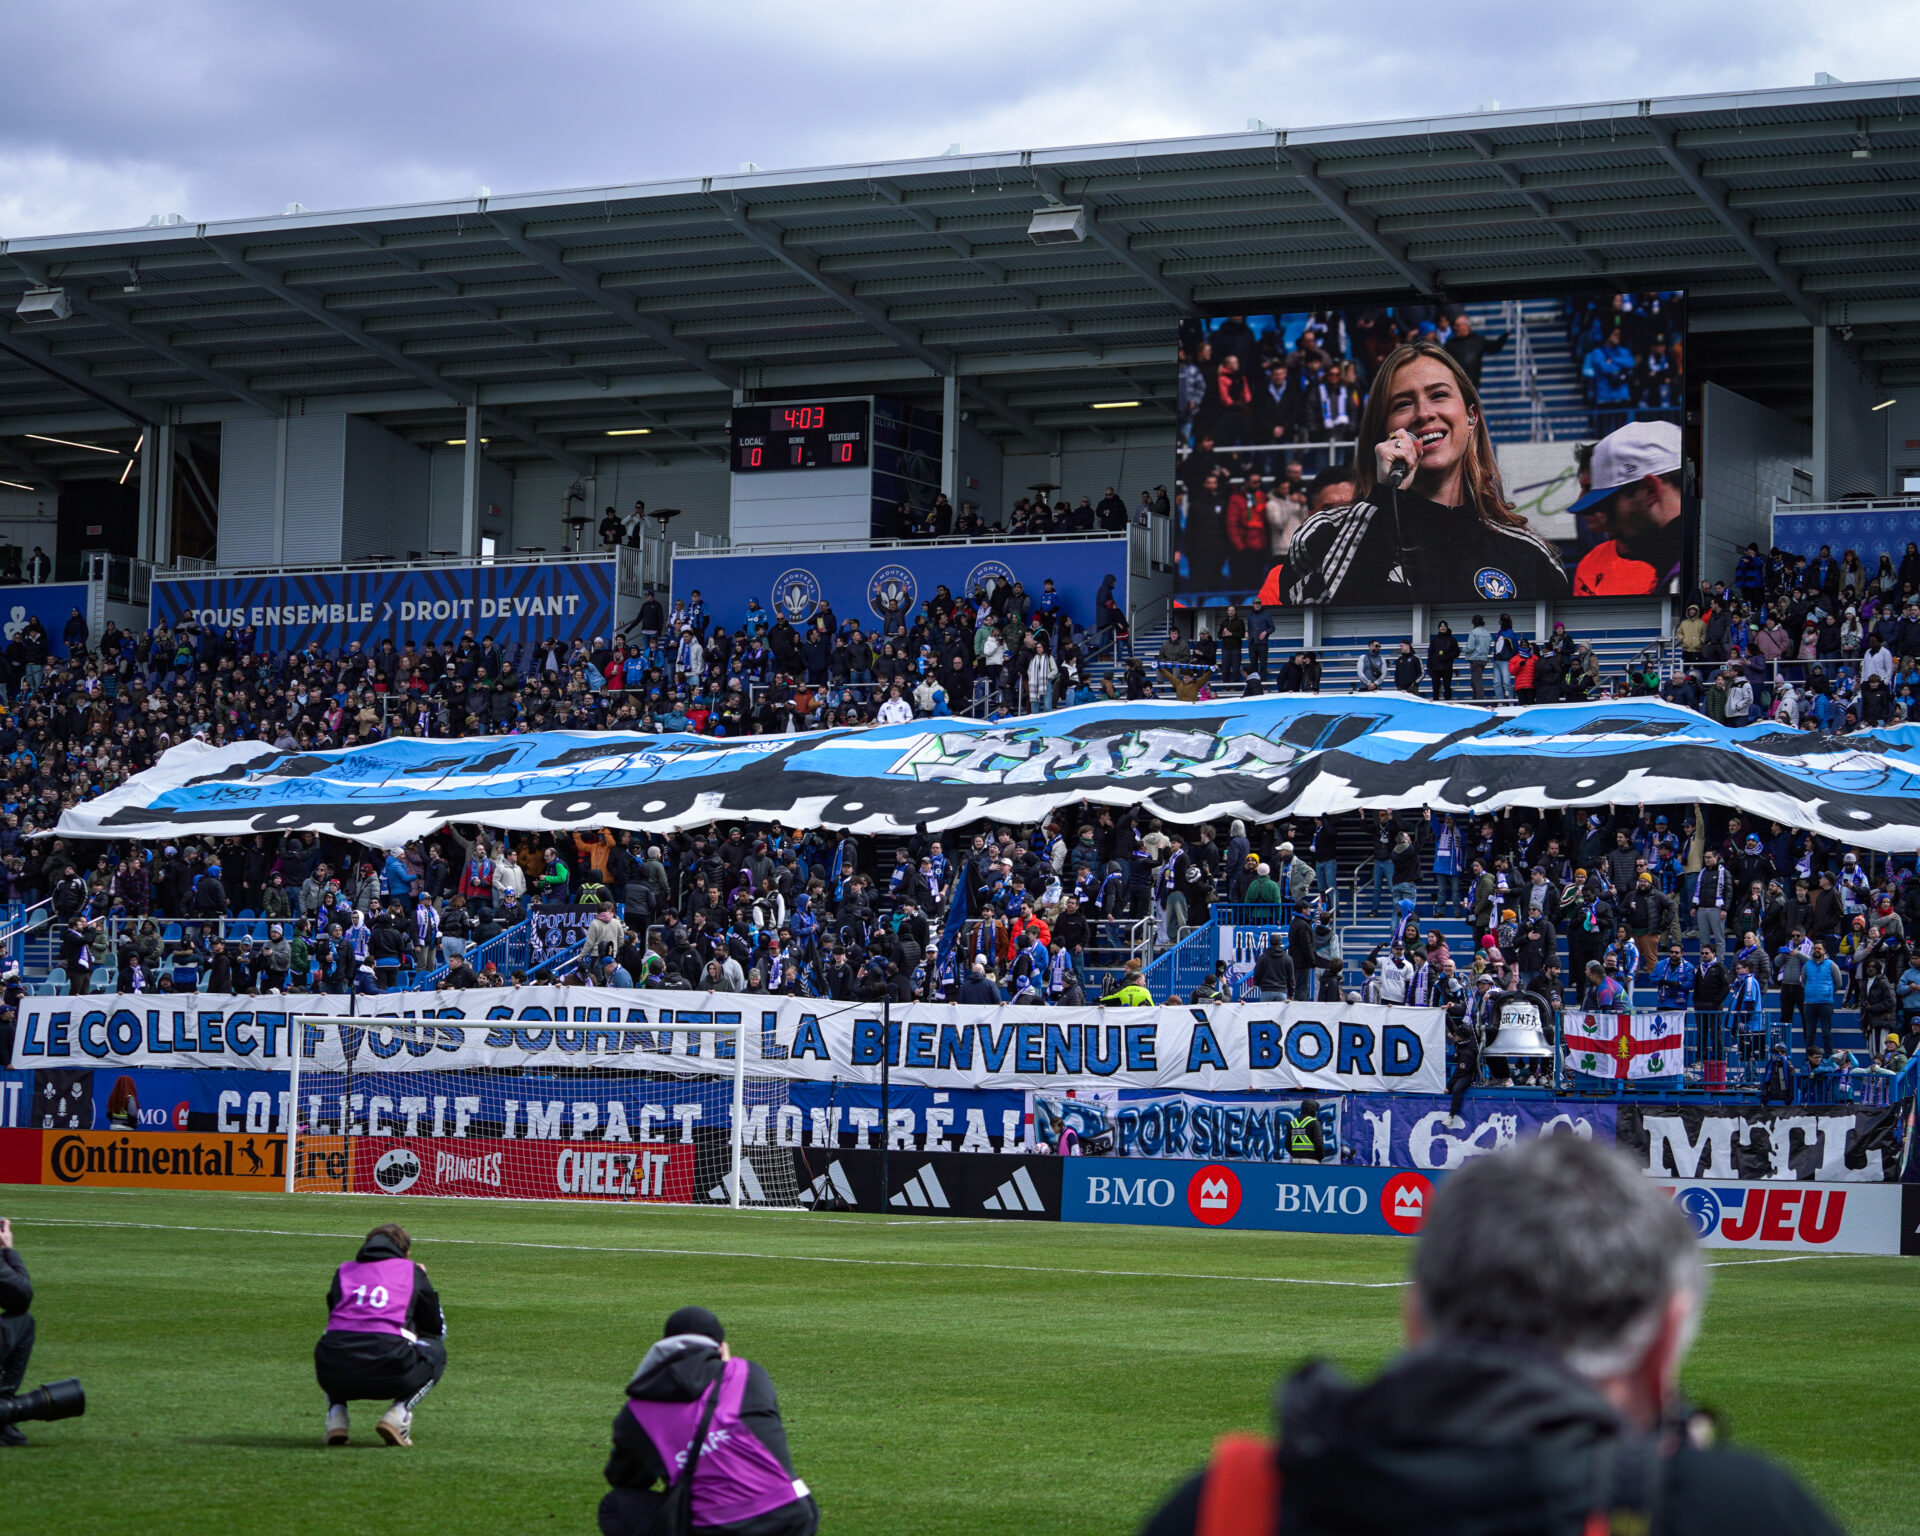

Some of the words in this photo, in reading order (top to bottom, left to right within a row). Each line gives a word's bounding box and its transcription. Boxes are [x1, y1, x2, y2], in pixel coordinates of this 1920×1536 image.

[785, 407, 824, 429] 4:03
[740, 437, 763, 446] LOCAL
[828, 432, 860, 441] VISITEURS
[841, 443, 852, 462] 0
[751, 448, 762, 466] 0
[797, 446, 802, 463] 1
[191, 607, 245, 628] TOUS
[251, 602, 374, 626] ENSEMBLE
[400, 599, 472, 622] DROIT
[480, 595, 580, 619] DEVANT
[22, 1011, 72, 1057] LE
[79, 1009, 324, 1058] COLLECTIF
[338, 1006, 466, 1060] VOUS
[484, 1005, 742, 1059] SOUHAITE
[760, 1010, 831, 1061] LA
[851, 1018, 1158, 1076] BIENVENUE
[1186, 1006, 1229, 1073] À
[1247, 1020, 1424, 1077] BORD
[502, 1100, 702, 1144] IMPACT
[728, 1092, 1025, 1153] MONTRÉAL
[1116, 1100, 1188, 1156] POR
[51, 1134, 234, 1182] Continental
[265, 1139, 346, 1178] Tire
[1642, 1115, 1884, 1182] MTL
[435, 1151, 502, 1187] PRINGLES
[1086, 1176, 1176, 1208] BMO
[1275, 1183, 1368, 1215] BMO
[353, 1285, 389, 1308] 10
